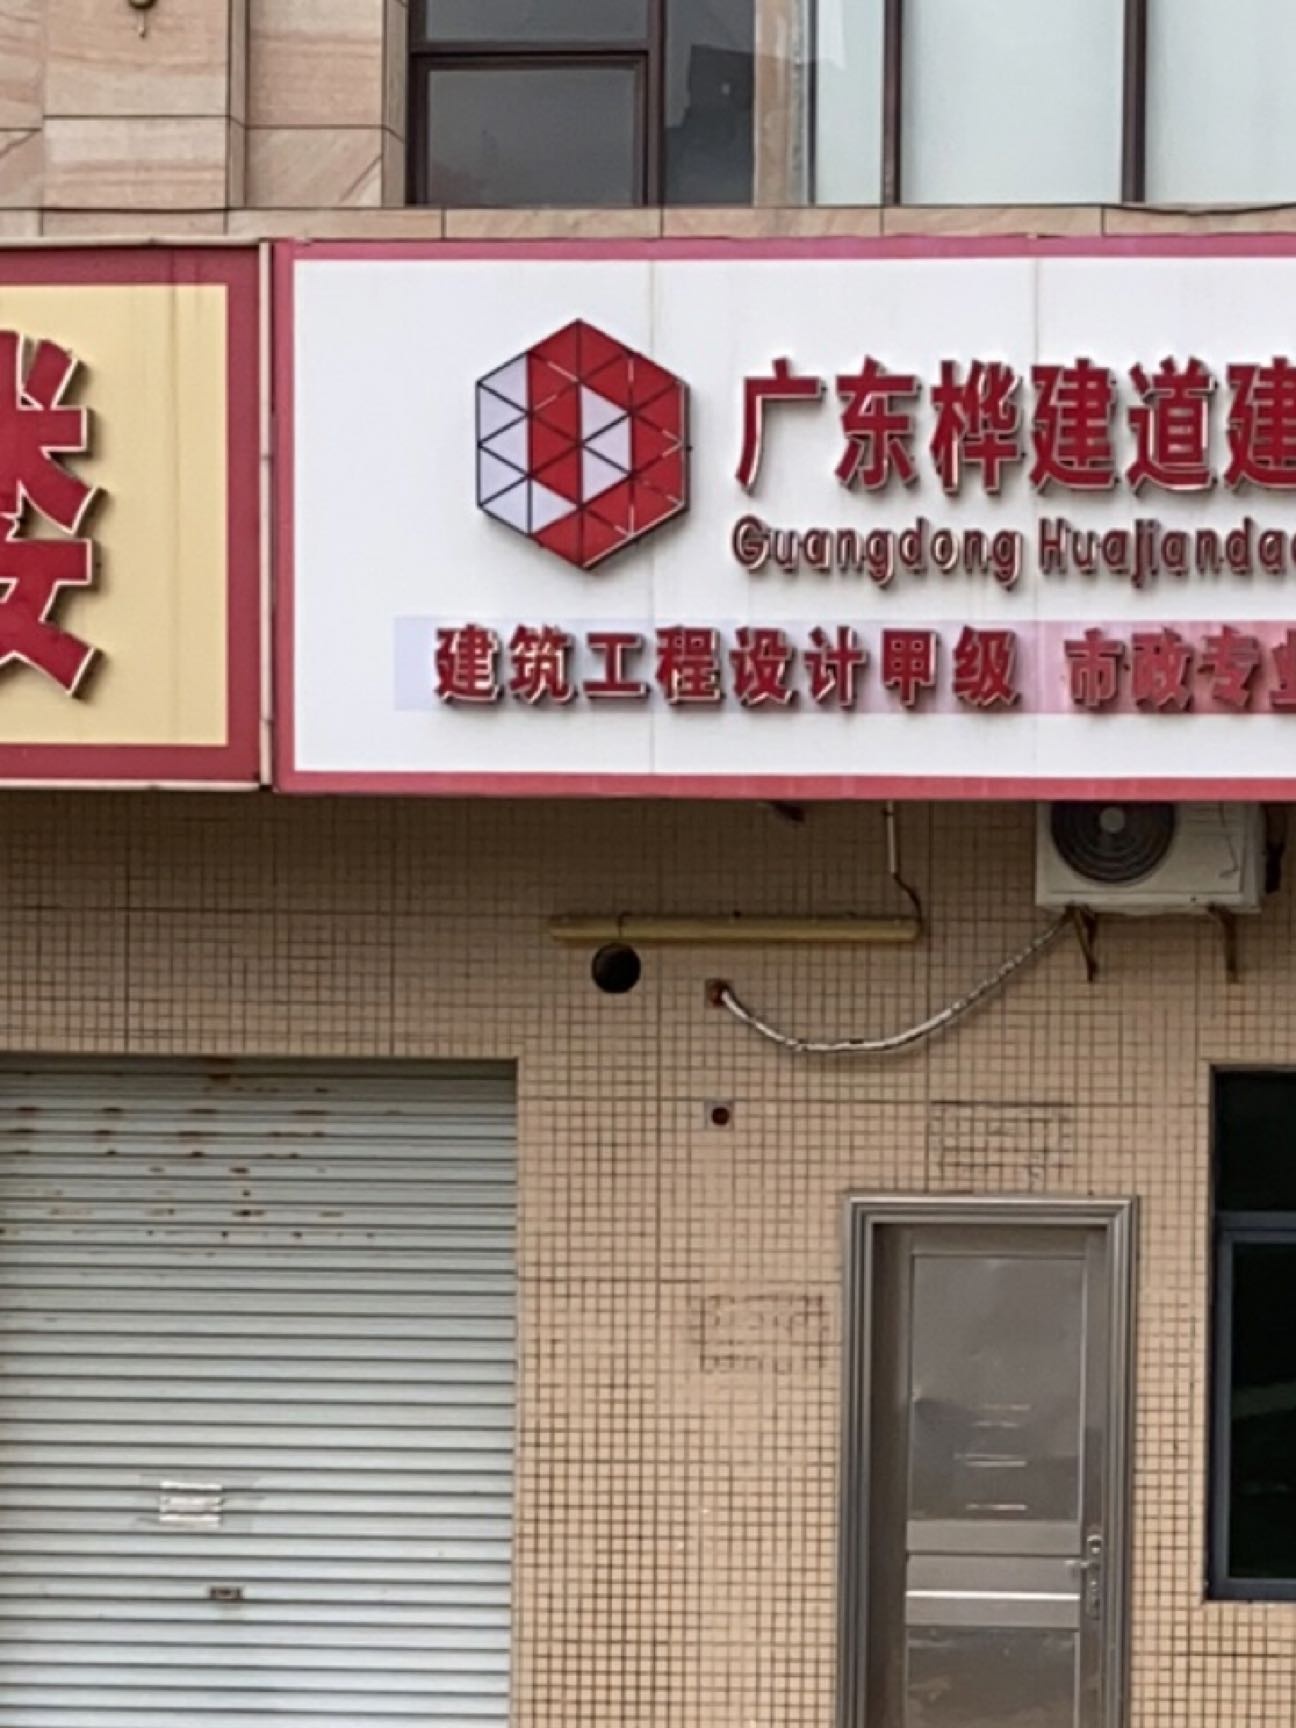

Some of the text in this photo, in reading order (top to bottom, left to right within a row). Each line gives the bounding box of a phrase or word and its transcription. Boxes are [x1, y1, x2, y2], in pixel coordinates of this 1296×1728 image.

[732, 516, 1022, 590] Guangdong
[434, 624, 1018, 708] 建筑工程设计甲级
